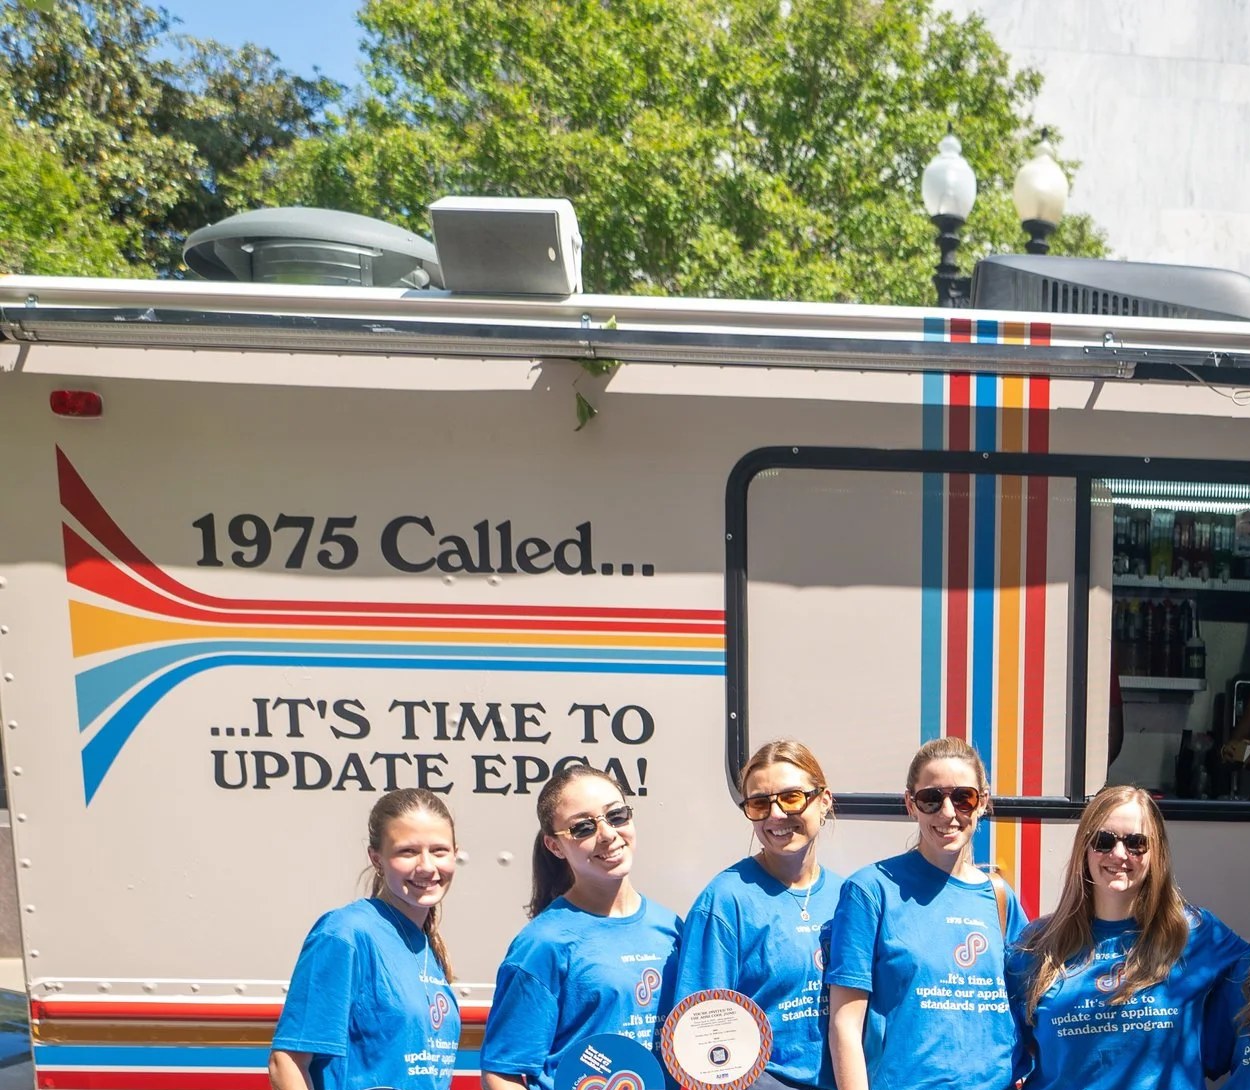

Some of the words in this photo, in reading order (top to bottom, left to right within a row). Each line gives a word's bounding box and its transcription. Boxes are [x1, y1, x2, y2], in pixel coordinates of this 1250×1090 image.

[191, 512, 359, 570] 1975
[381, 514, 655, 576] Called...
[210, 698, 370, 740] ...IT'S
[389, 700, 551, 744] TIME
[567, 703, 655, 746] TO
[211, 750, 453, 795] UPDATE
[940, 974, 965, 985] ...It's
[968, 975, 993, 986] time
[916, 986, 952, 997] update
[954, 989, 976, 998] our
[778, 996, 814, 1010] update
[920, 999, 975, 1010] standards
[978, 1004, 1010, 1013] progr
[1074, 998, 1105, 1010] ...It's
[1141, 994, 1155, 1004] to
[782, 1006, 830, 1022] standard
[1051, 1012, 1091, 1026] update
[1094, 1011, 1116, 1020] our
[1121, 1006, 1179, 1020] appliance
[1057, 1022, 1118, 1038] standards
[1122, 1020, 1174, 1032] program
